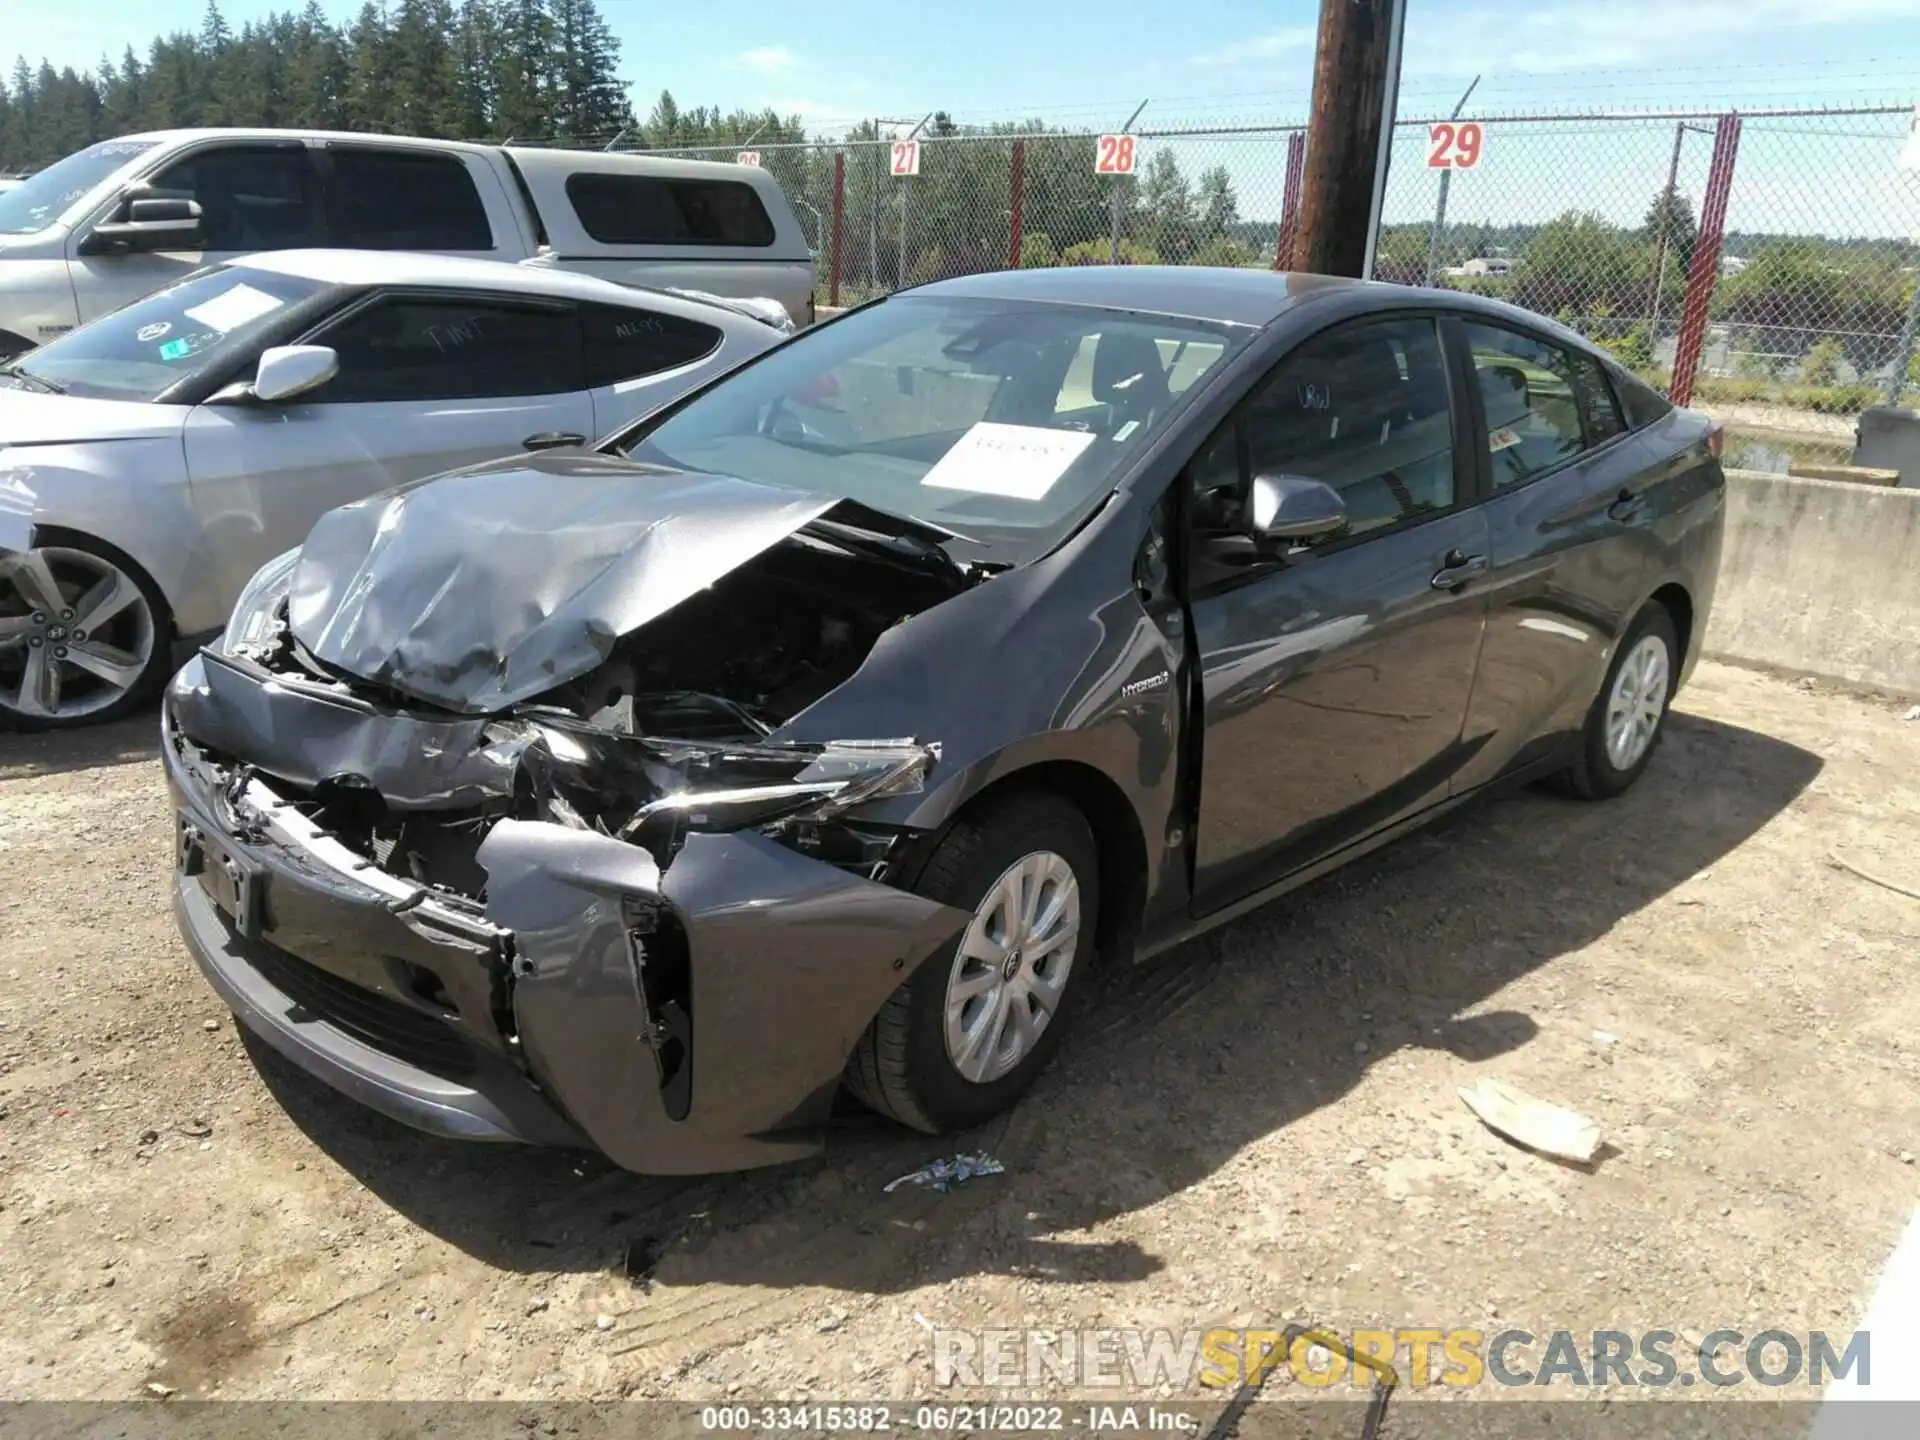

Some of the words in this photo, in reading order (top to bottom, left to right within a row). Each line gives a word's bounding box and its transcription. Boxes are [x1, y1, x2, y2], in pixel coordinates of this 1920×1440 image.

[894, 142, 917, 174] 27
[1100, 135, 1134, 172] 28
[1428, 123, 1482, 168] 29
